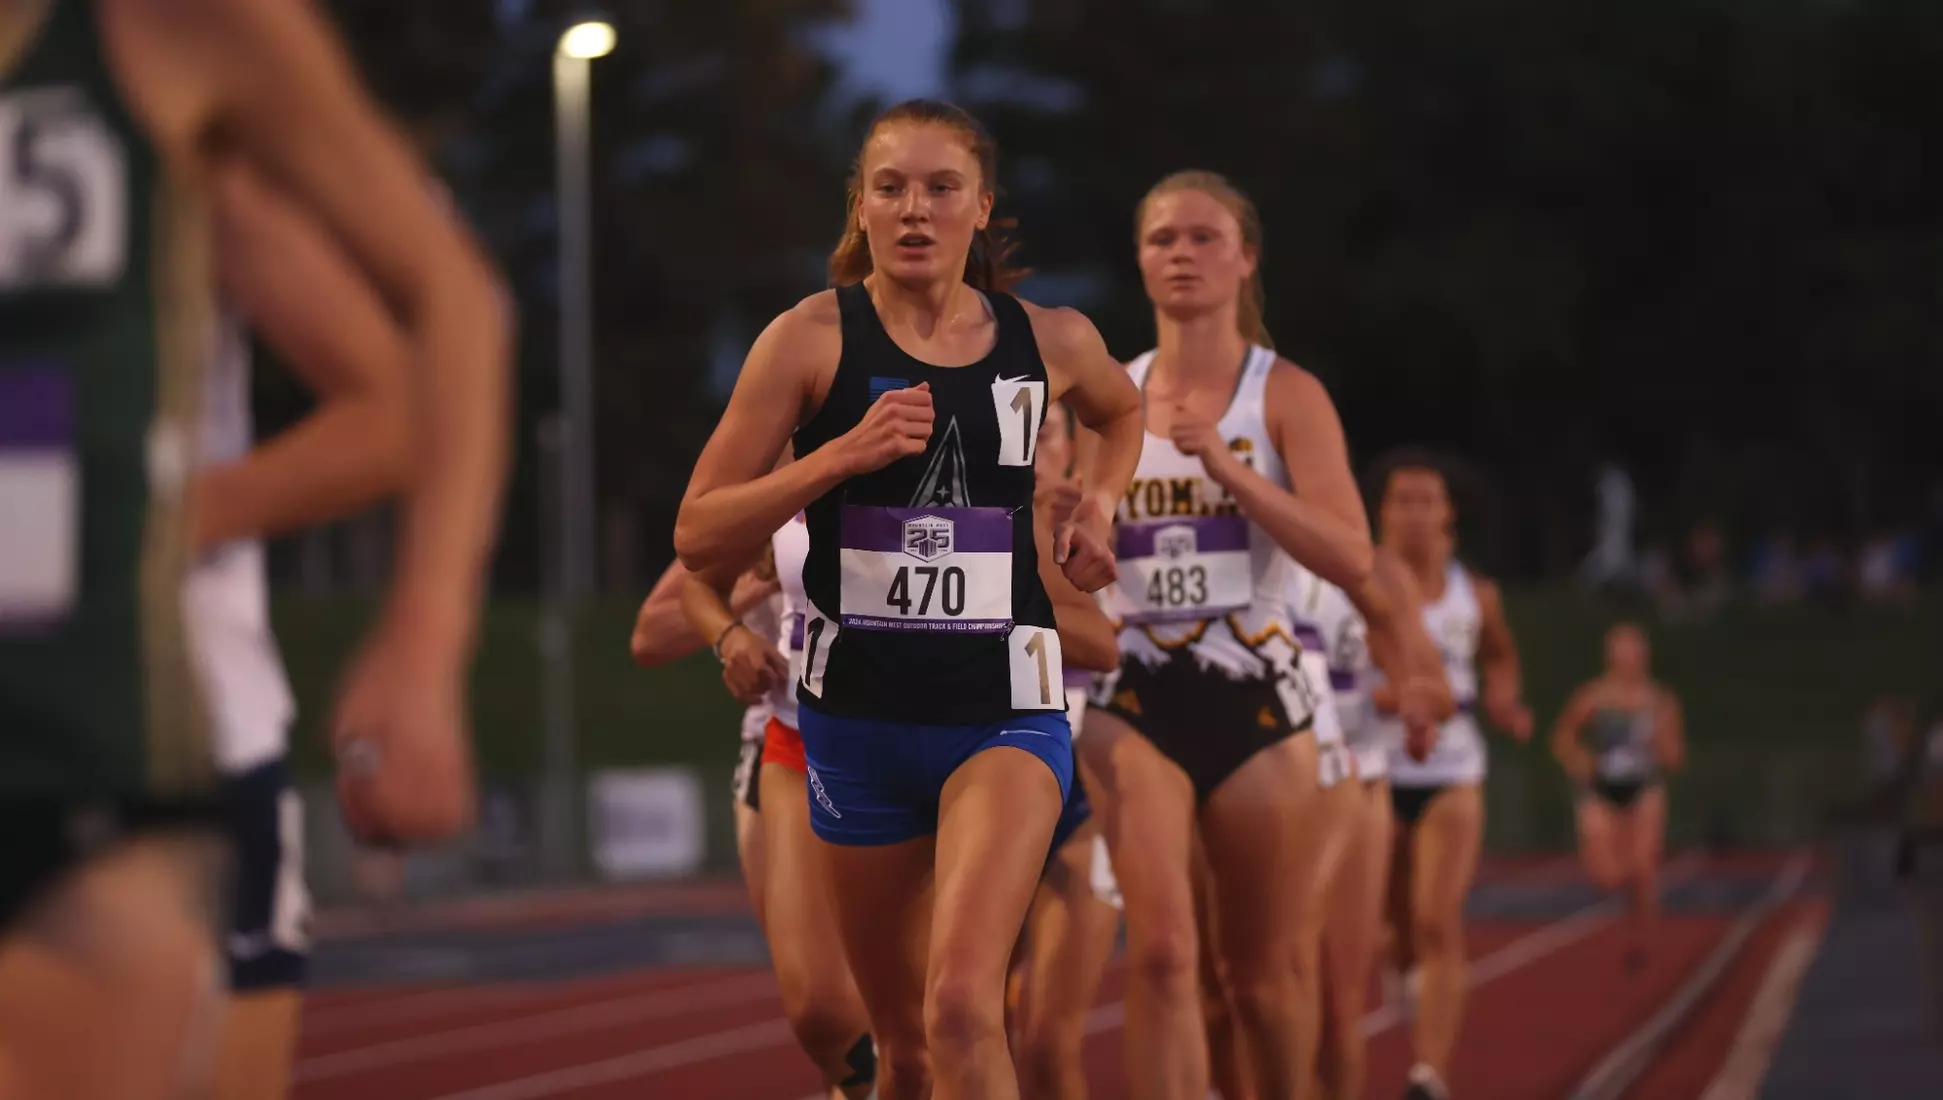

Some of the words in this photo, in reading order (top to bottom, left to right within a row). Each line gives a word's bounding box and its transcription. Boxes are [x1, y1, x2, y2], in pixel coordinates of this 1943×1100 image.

[1008, 387, 1032, 461] 1
[907, 529, 949, 548] 25
[887, 566, 966, 616] 470
[1147, 566, 1208, 606] 483
[888, 621, 902, 629] WEST
[903, 622, 927, 630] OUTDOOR
[928, 622, 946, 630] TRACK
[952, 622, 967, 630] FIELD
[808, 616, 825, 687] 1
[1024, 632, 1051, 704] 1
